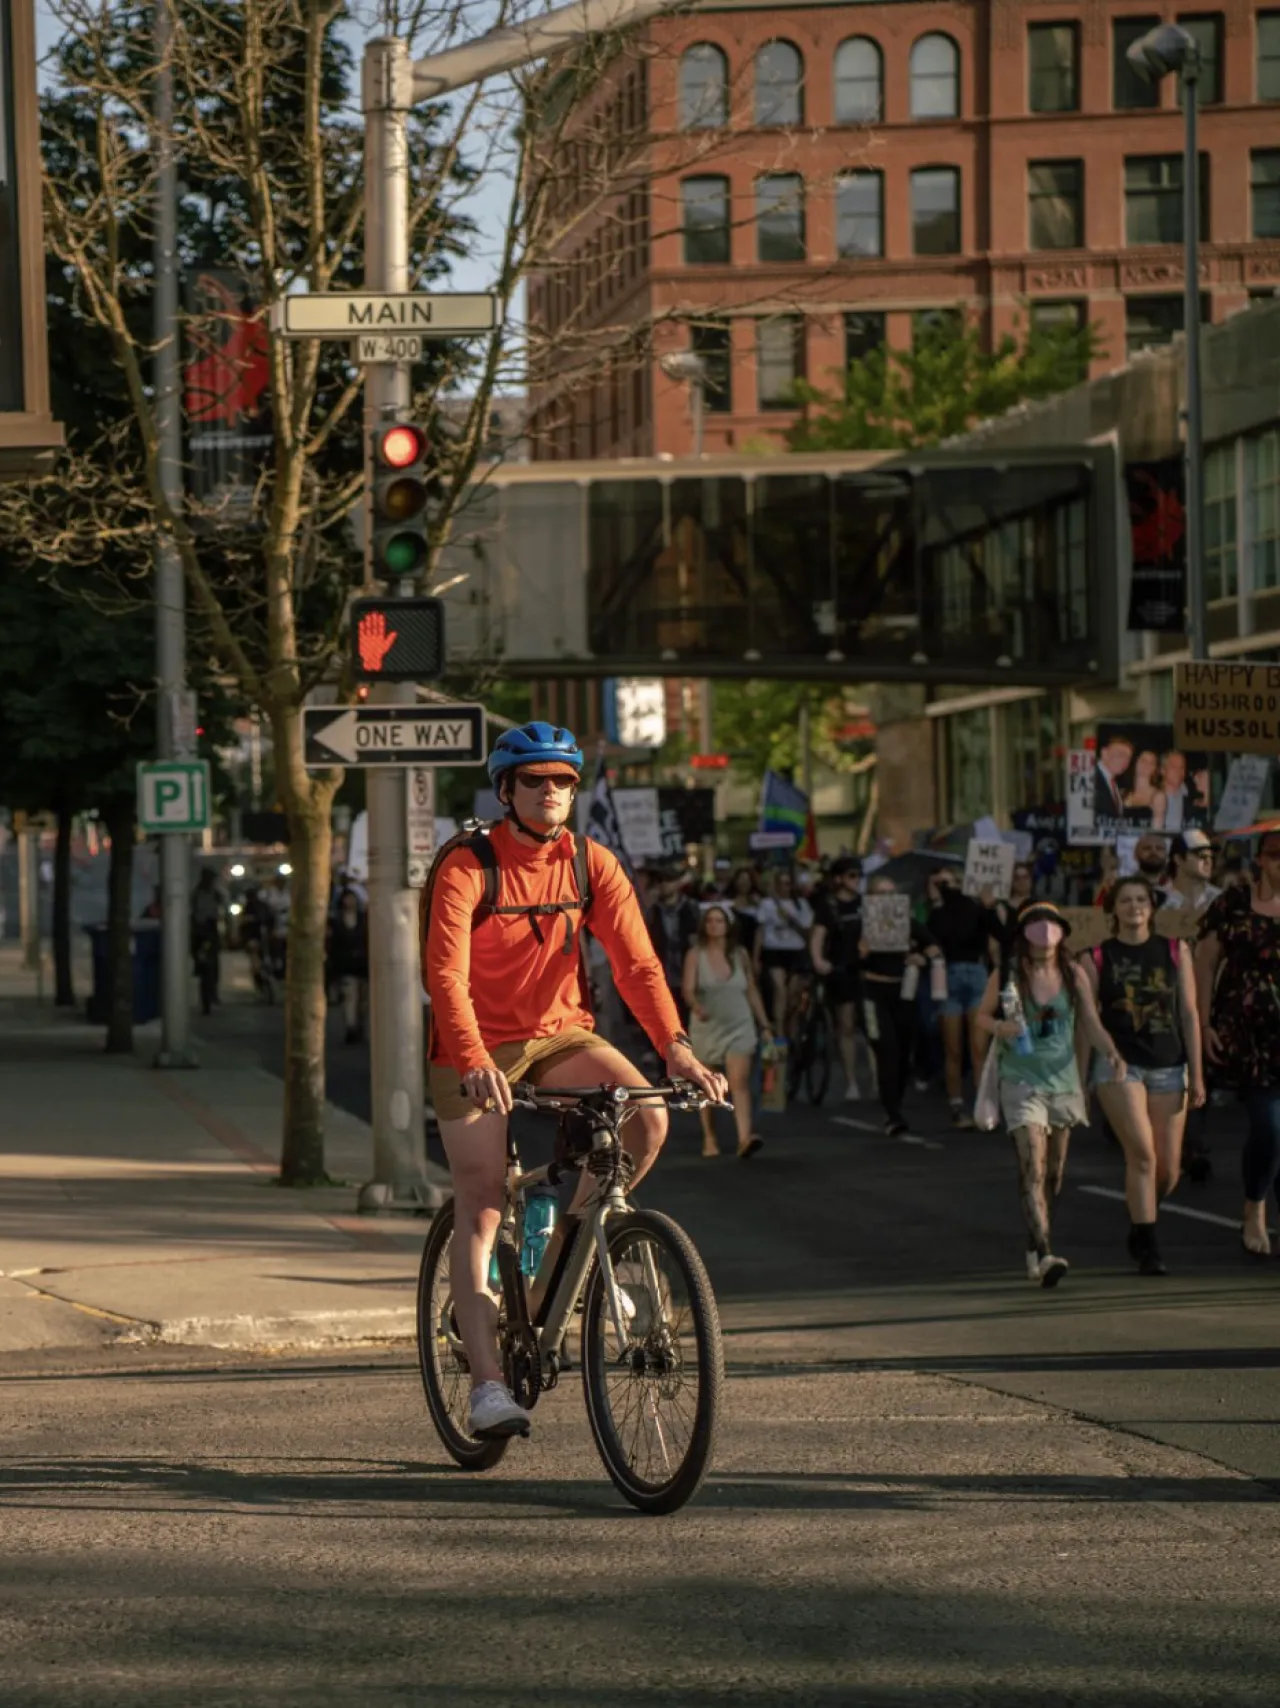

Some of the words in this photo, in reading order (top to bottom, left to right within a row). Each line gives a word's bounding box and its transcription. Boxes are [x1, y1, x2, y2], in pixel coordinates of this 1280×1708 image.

[348, 302, 433, 324] MAIN
[1184, 663, 1255, 688] HAPPY
[356, 725, 403, 747] ONE
[415, 723, 465, 746] WAY
[154, 781, 181, 817] P
